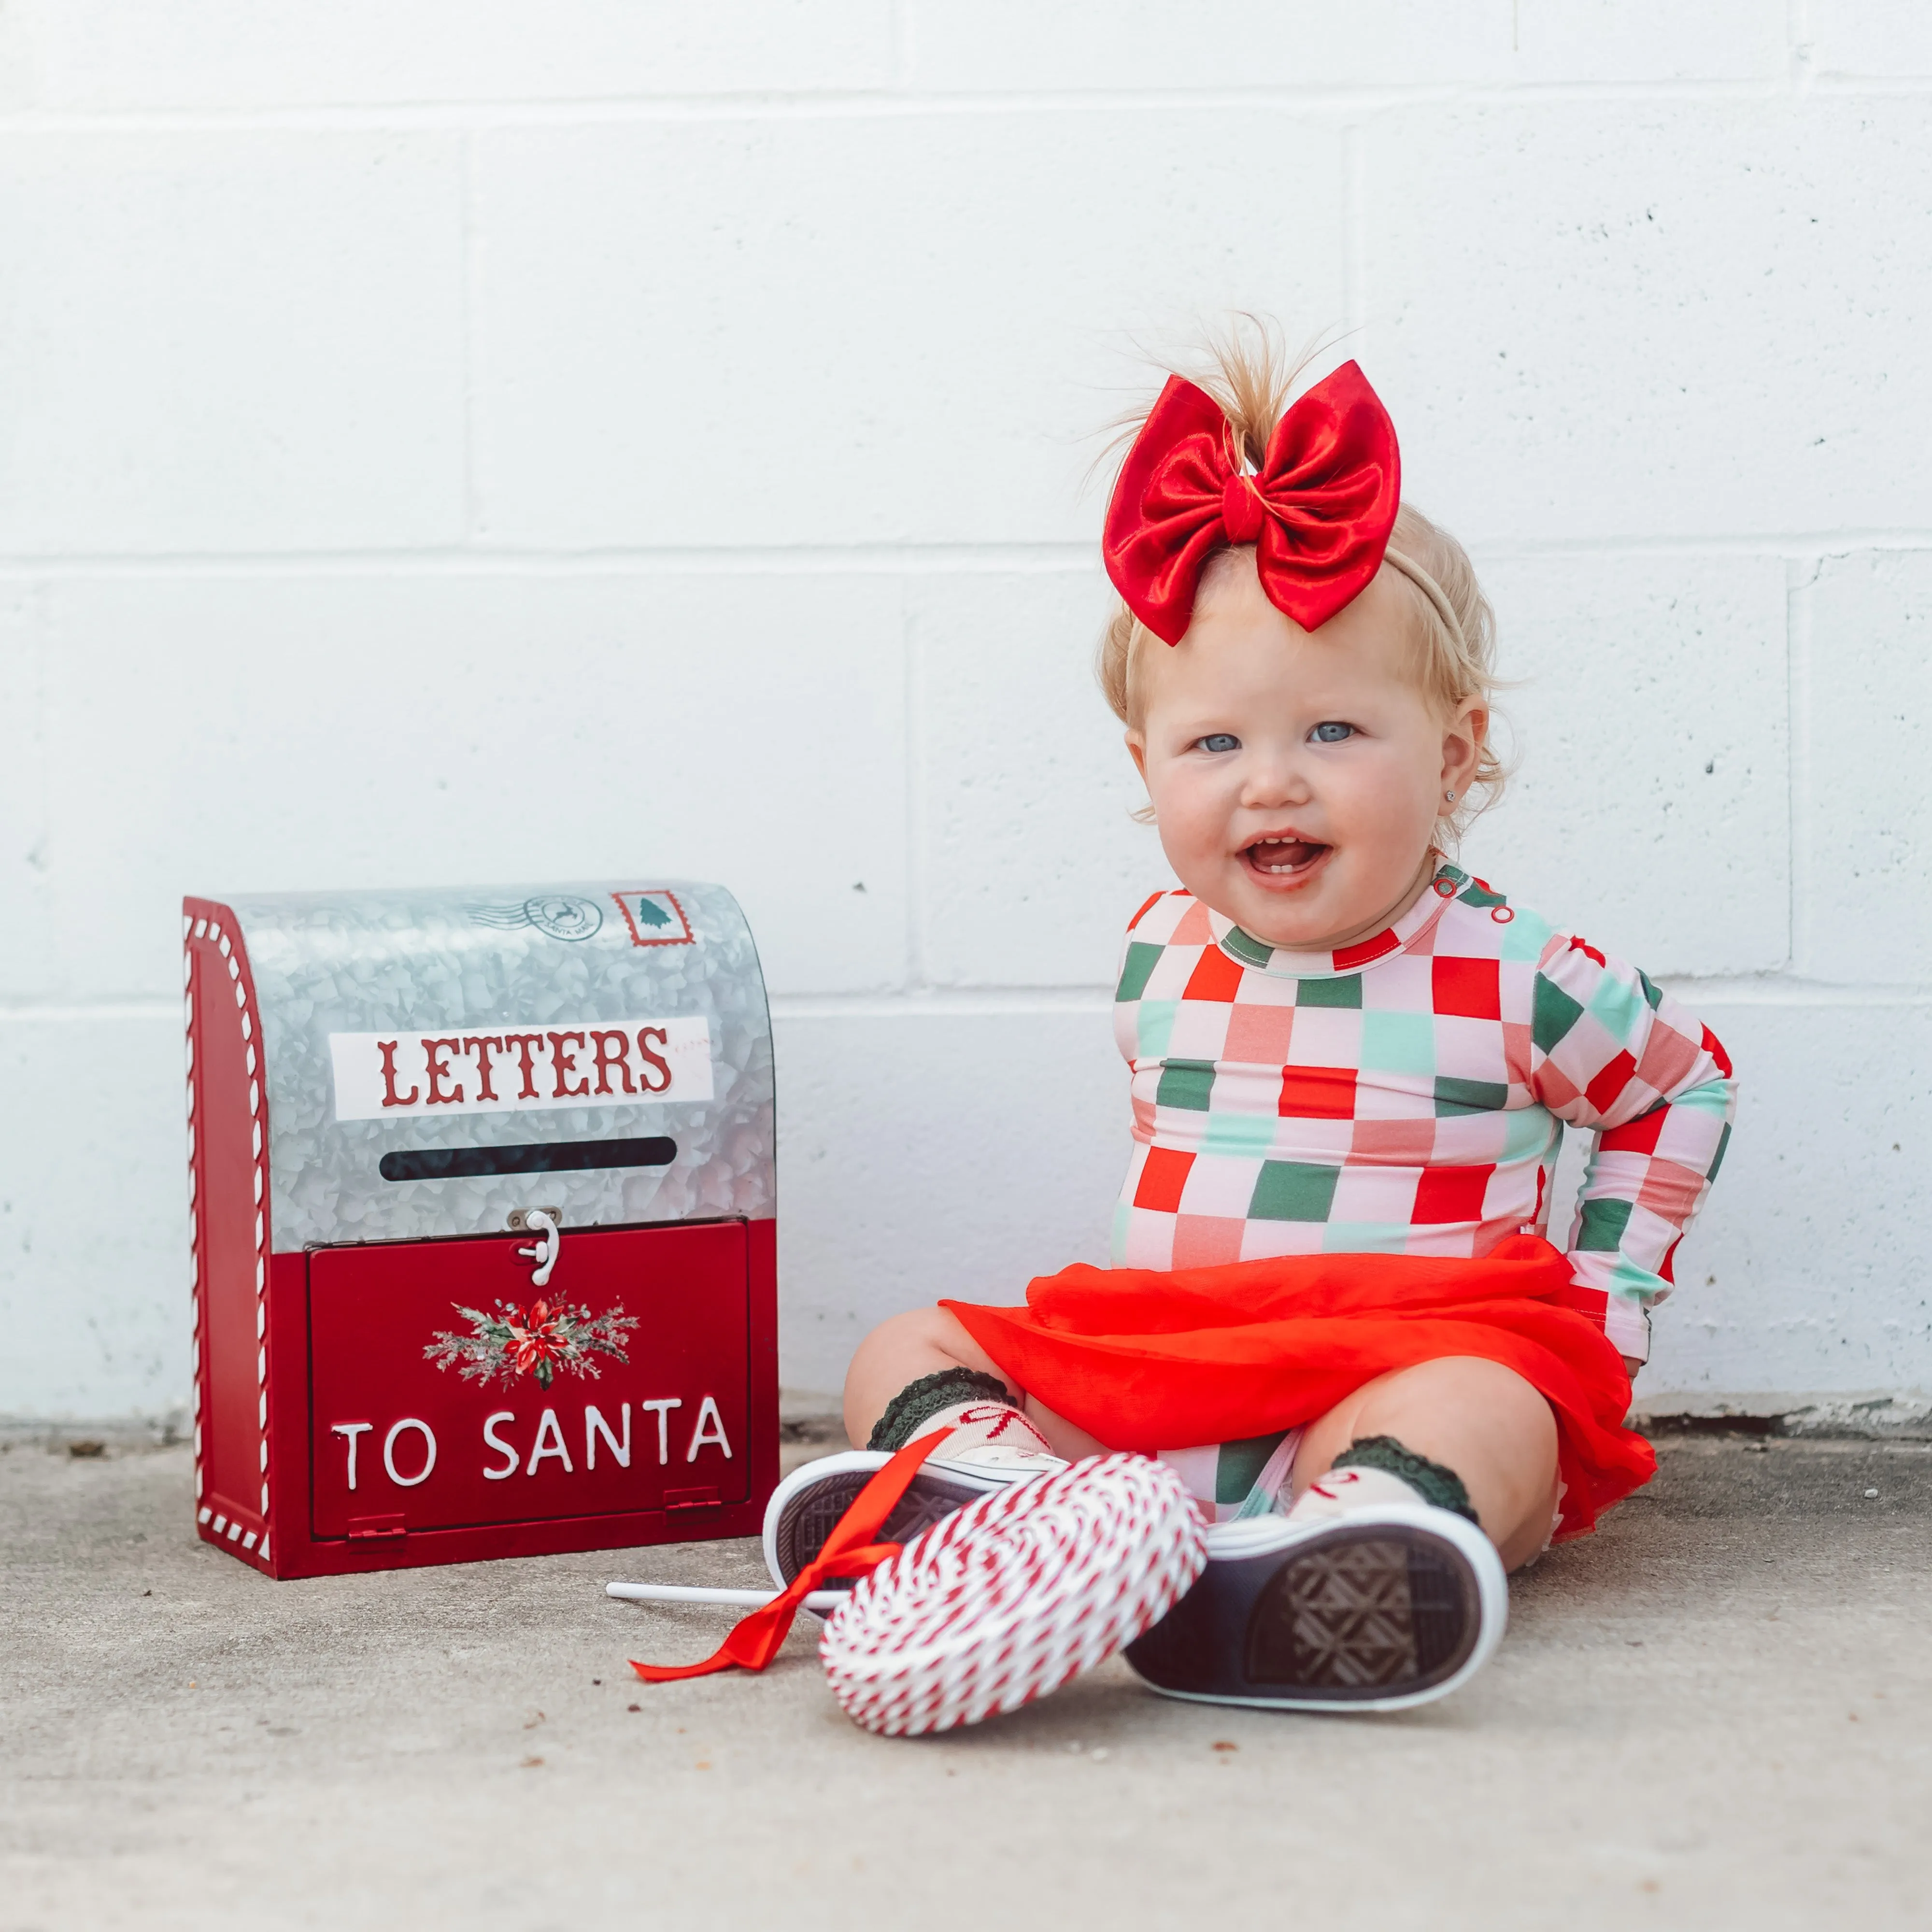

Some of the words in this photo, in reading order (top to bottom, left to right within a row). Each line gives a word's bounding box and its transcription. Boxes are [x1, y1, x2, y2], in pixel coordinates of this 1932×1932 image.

[379, 1027, 671, 1107] LETTERS
[331, 1418, 437, 1490] TO
[483, 1396, 732, 1479] SANTA
